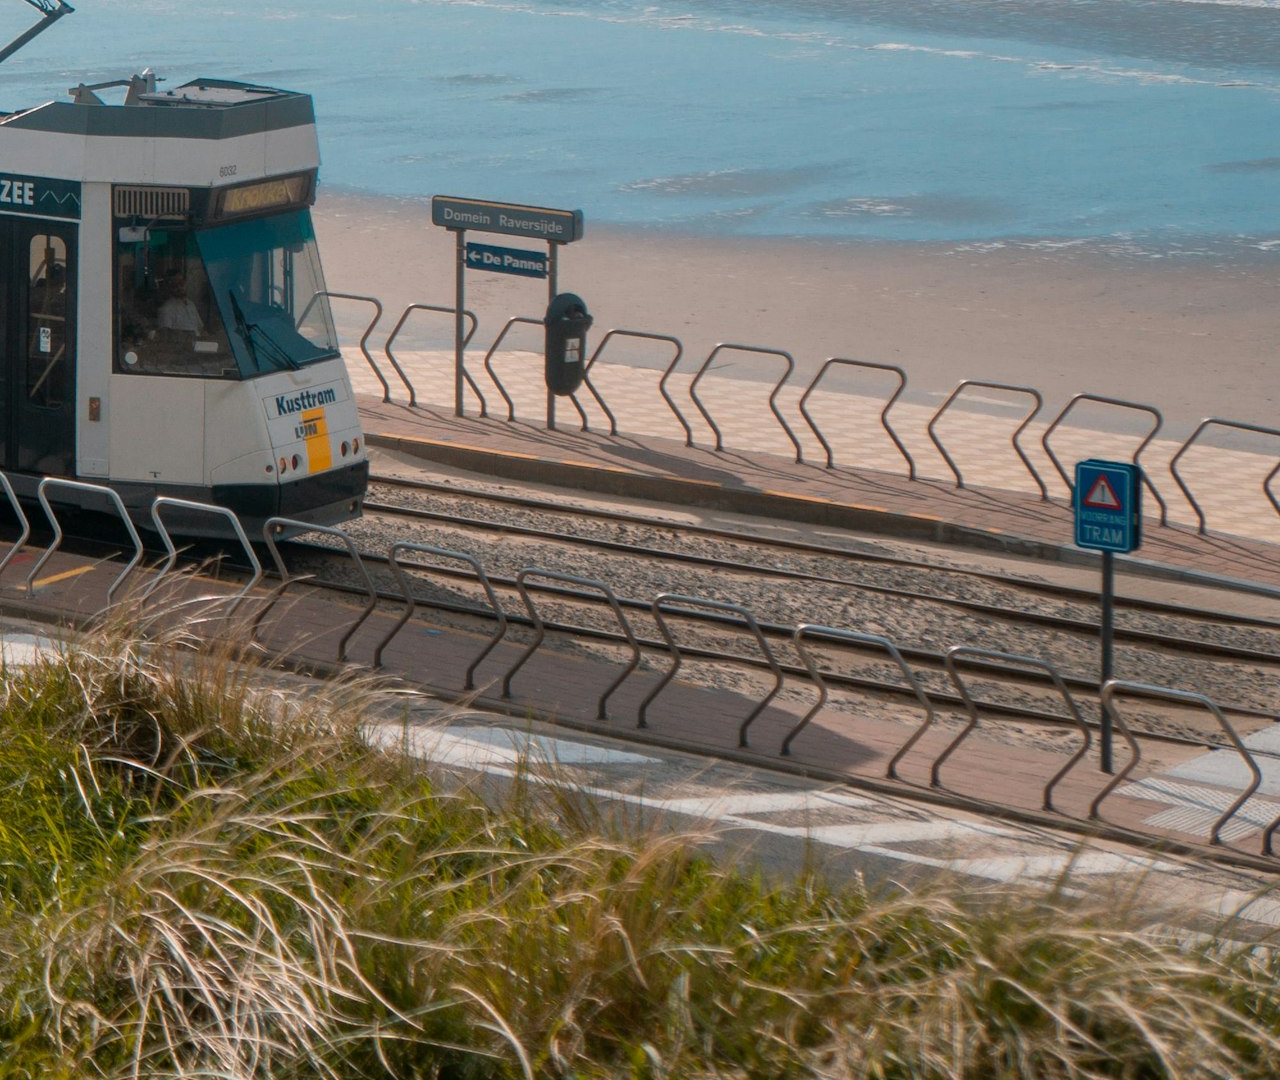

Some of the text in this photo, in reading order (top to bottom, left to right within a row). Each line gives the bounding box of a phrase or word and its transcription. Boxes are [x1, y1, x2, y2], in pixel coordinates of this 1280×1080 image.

[0, 180, 35, 206] ZEE
[443, 207, 564, 235] Domein Raversijde
[483, 252, 545, 271] De Panne
[275, 387, 336, 416] Kusttram
[1083, 524, 1123, 544] TRAM
